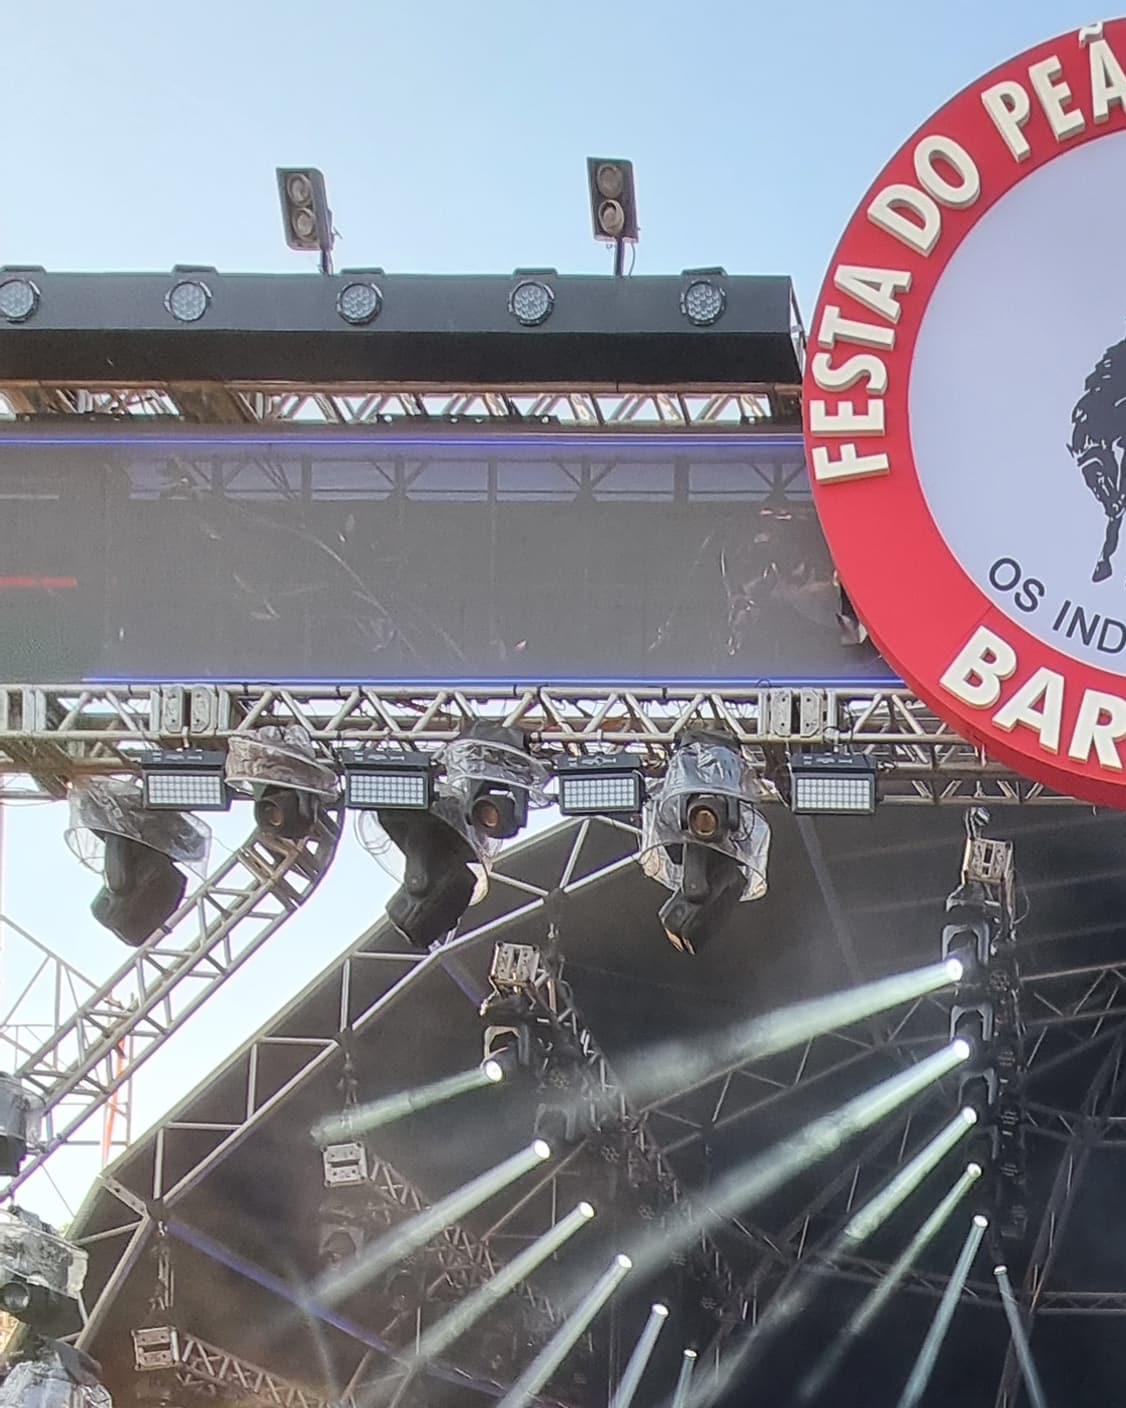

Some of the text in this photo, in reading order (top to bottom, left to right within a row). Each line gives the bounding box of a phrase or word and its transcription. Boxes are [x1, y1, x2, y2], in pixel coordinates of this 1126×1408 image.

[811, 263, 912, 484] FESTA
[866, 133, 981, 256] DO
[988, 557, 1046, 613] OS
